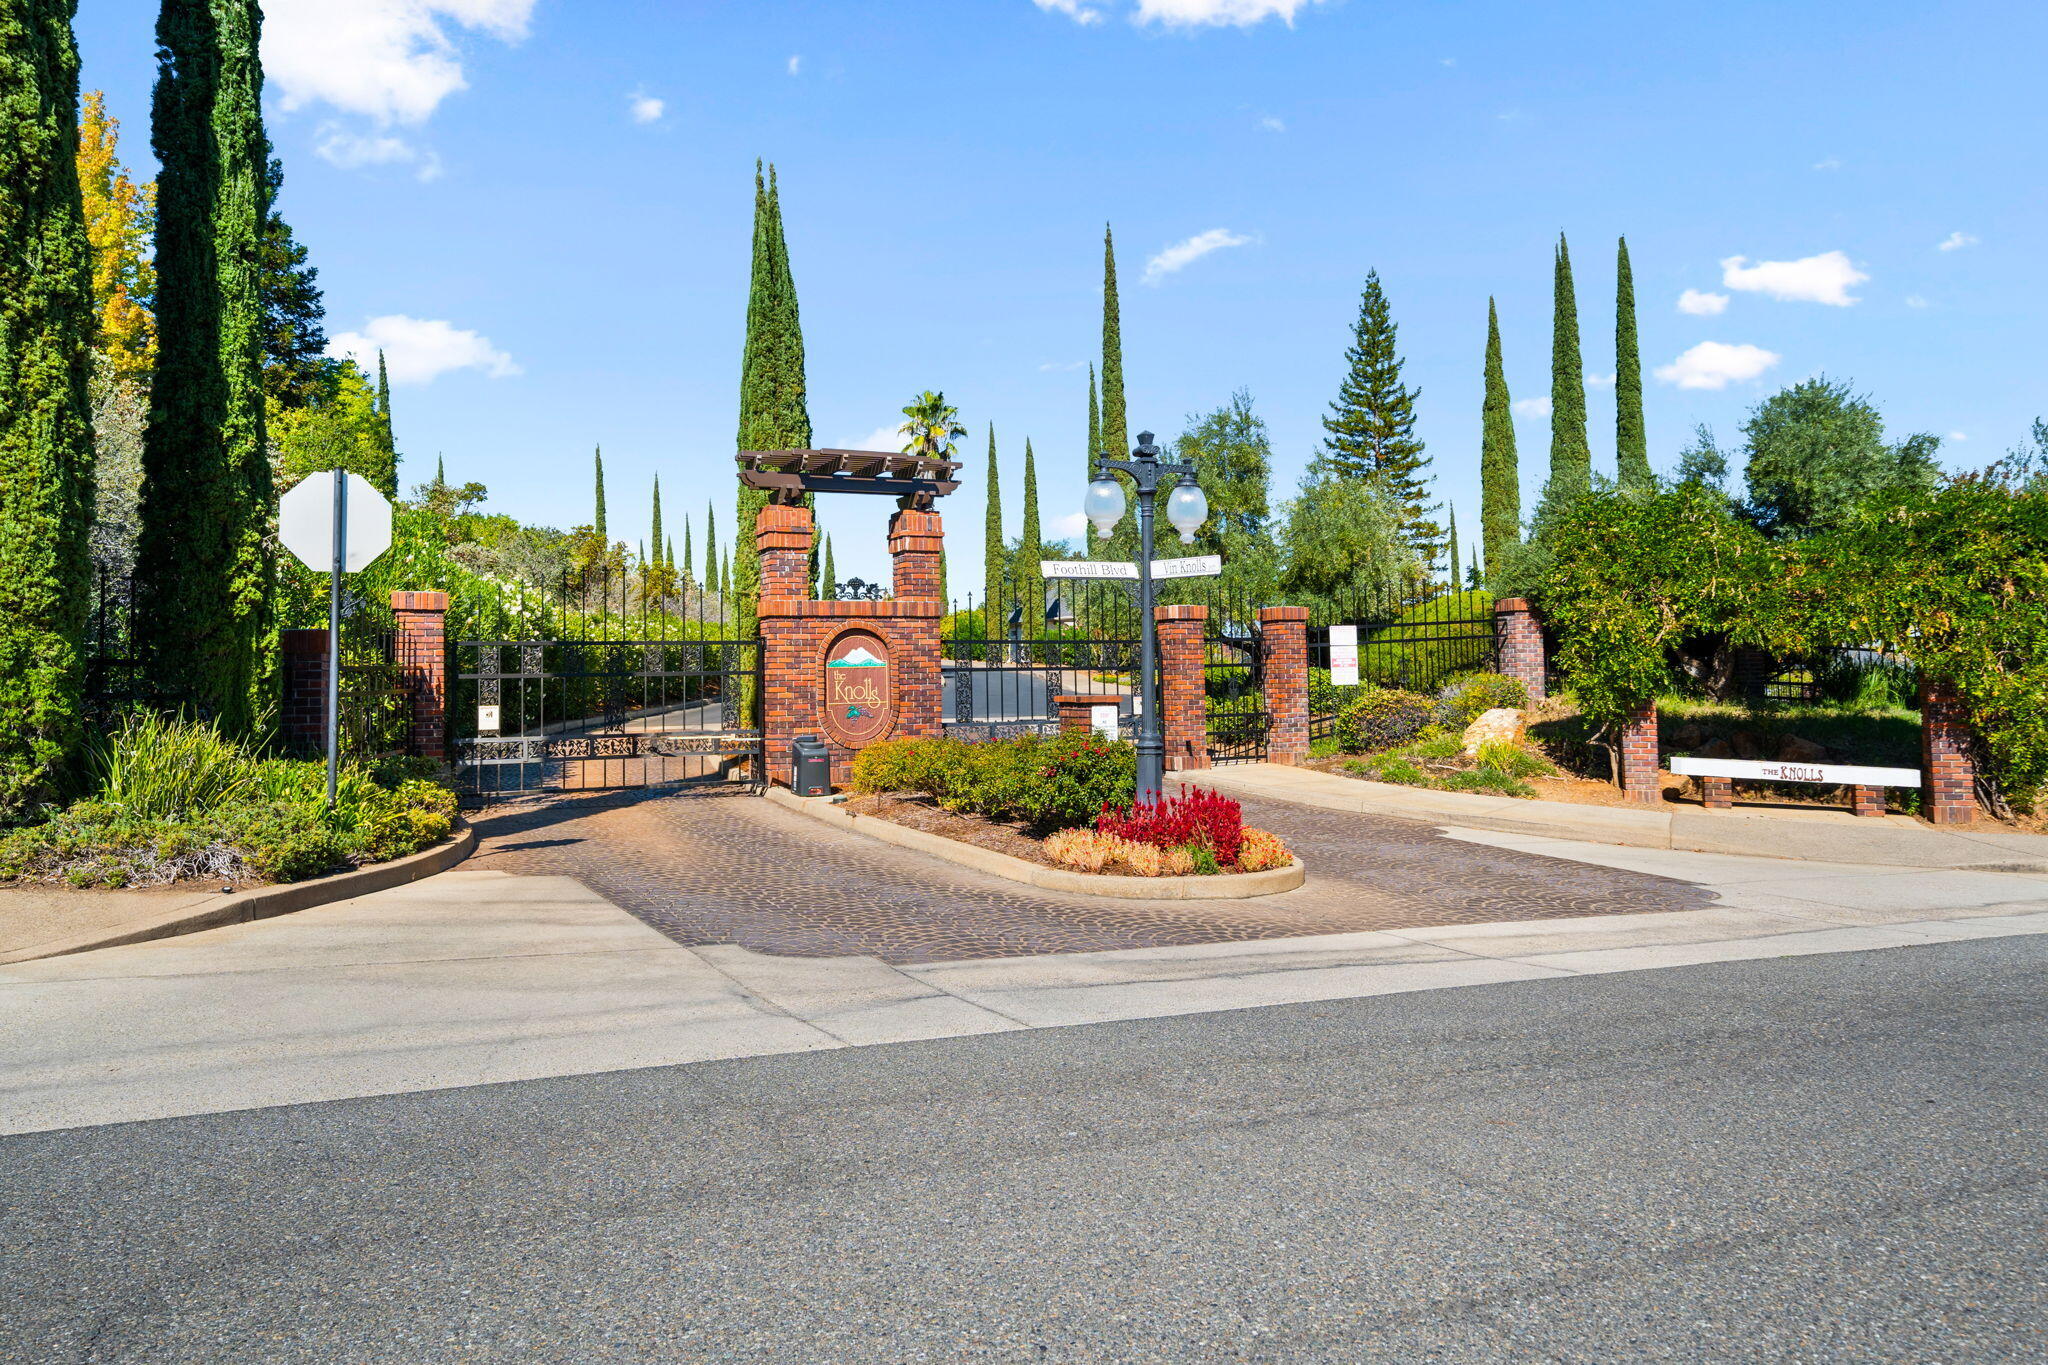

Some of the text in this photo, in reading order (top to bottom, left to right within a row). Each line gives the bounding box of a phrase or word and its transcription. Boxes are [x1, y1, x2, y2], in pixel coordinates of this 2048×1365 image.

[1053, 563, 1128, 576] Foothill Blvd
[1163, 561, 1178, 575] Vin
[1180, 558, 1207, 573] Knolls
[833, 670, 847, 680] the
[834, 678, 881, 709] Knolls
[1762, 765, 1824, 783] THE KNOLLS
